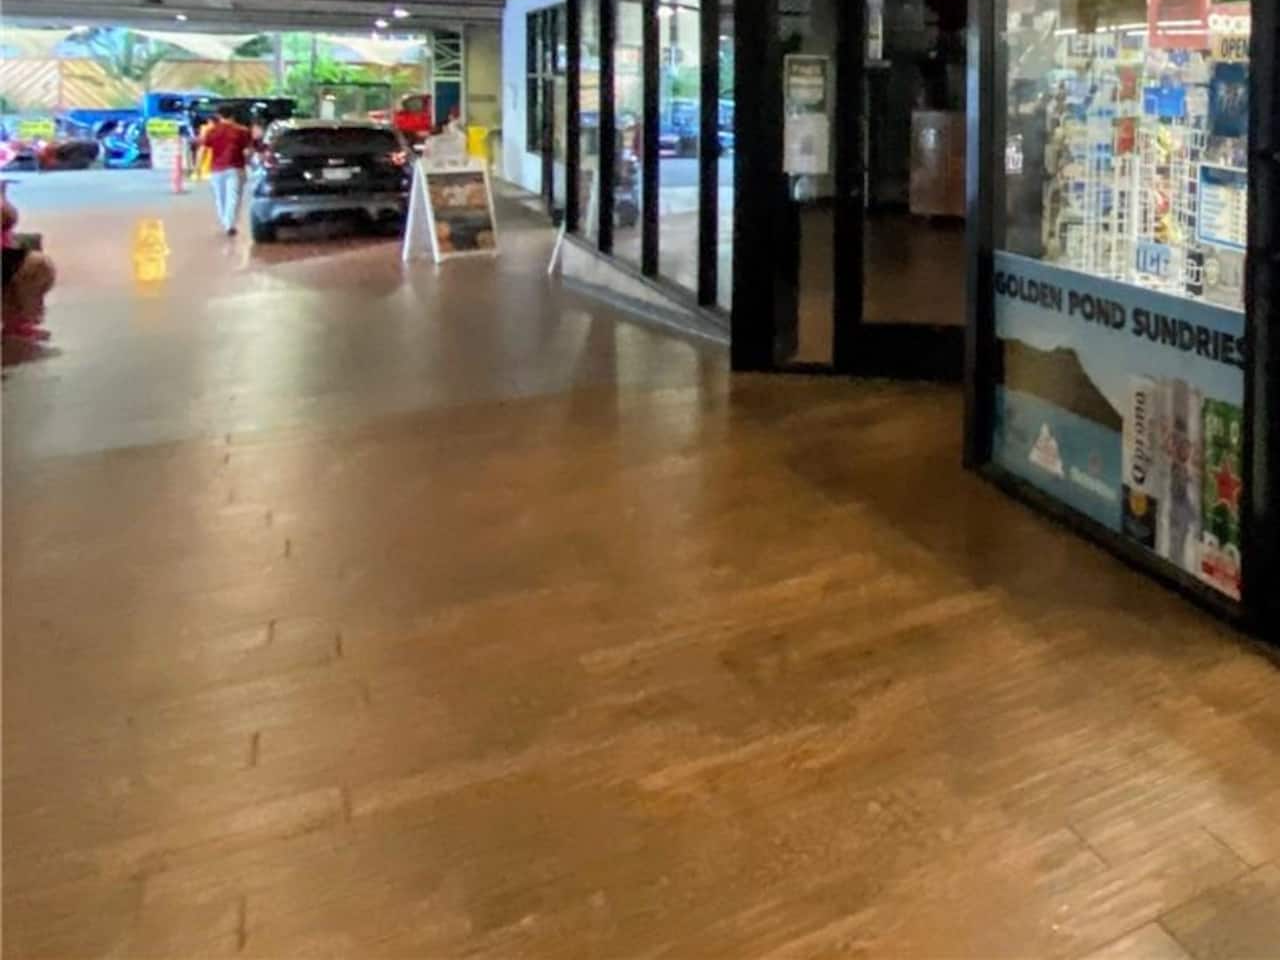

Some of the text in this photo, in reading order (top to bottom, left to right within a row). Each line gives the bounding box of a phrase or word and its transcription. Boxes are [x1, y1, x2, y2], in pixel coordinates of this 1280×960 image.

[994, 270, 1247, 370] GOLDEN POND SUNDRIES
